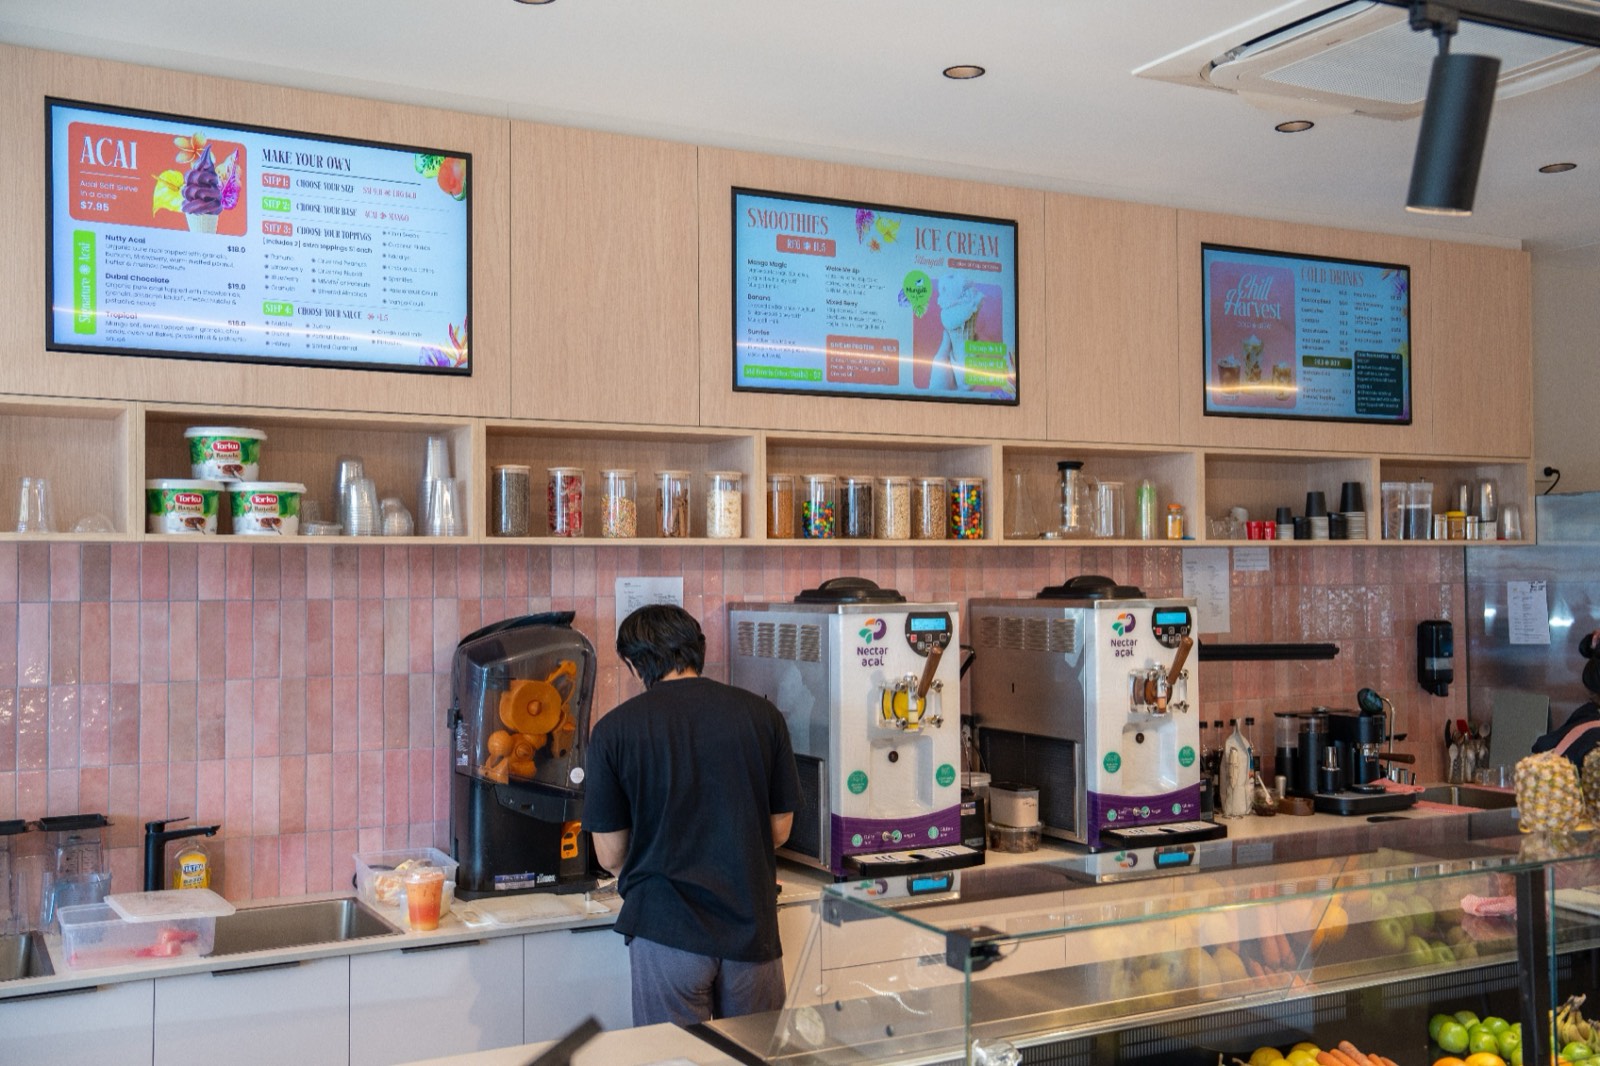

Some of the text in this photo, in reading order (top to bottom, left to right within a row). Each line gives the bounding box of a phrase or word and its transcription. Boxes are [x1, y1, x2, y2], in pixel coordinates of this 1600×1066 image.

[80, 136, 138, 170] ACAI
[262, 148, 350, 171] MAKE YOUR OWN
[264, 176, 281, 186] STEP
[296, 180, 354, 193] CHOOSE YOUR SIZE
[80, 200, 110, 212] $7.95
[264, 199, 290, 210] STEP 2:
[296, 202, 356, 216] CHOOSE YOUR BASE
[747, 207, 829, 235] SMOOTHIES
[264, 223, 280, 233] STEP
[296, 226, 372, 241] CHOOSE YOUR TOPPINGS
[105, 234, 126, 243] Nutty
[915, 226, 999, 258] ICE CREAM
[748, 259, 768, 267] Mango
[130, 275, 170, 284] Chocolate
[1301, 266, 1364, 288] COLD DRINKS
[1238, 272, 1274, 300] Chill
[266, 304, 283, 313] STEP
[1224, 288, 1281, 320] Harvest
[106, 311, 138, 320] Tropical
[298, 307, 363, 319] CHOOSE YOUR SAUCE
[179, 495, 201, 503] Torku
[255, 495, 277, 503] Torku
[1110, 638, 1138, 648] Nectar
[857, 647, 889, 656] Nectar
